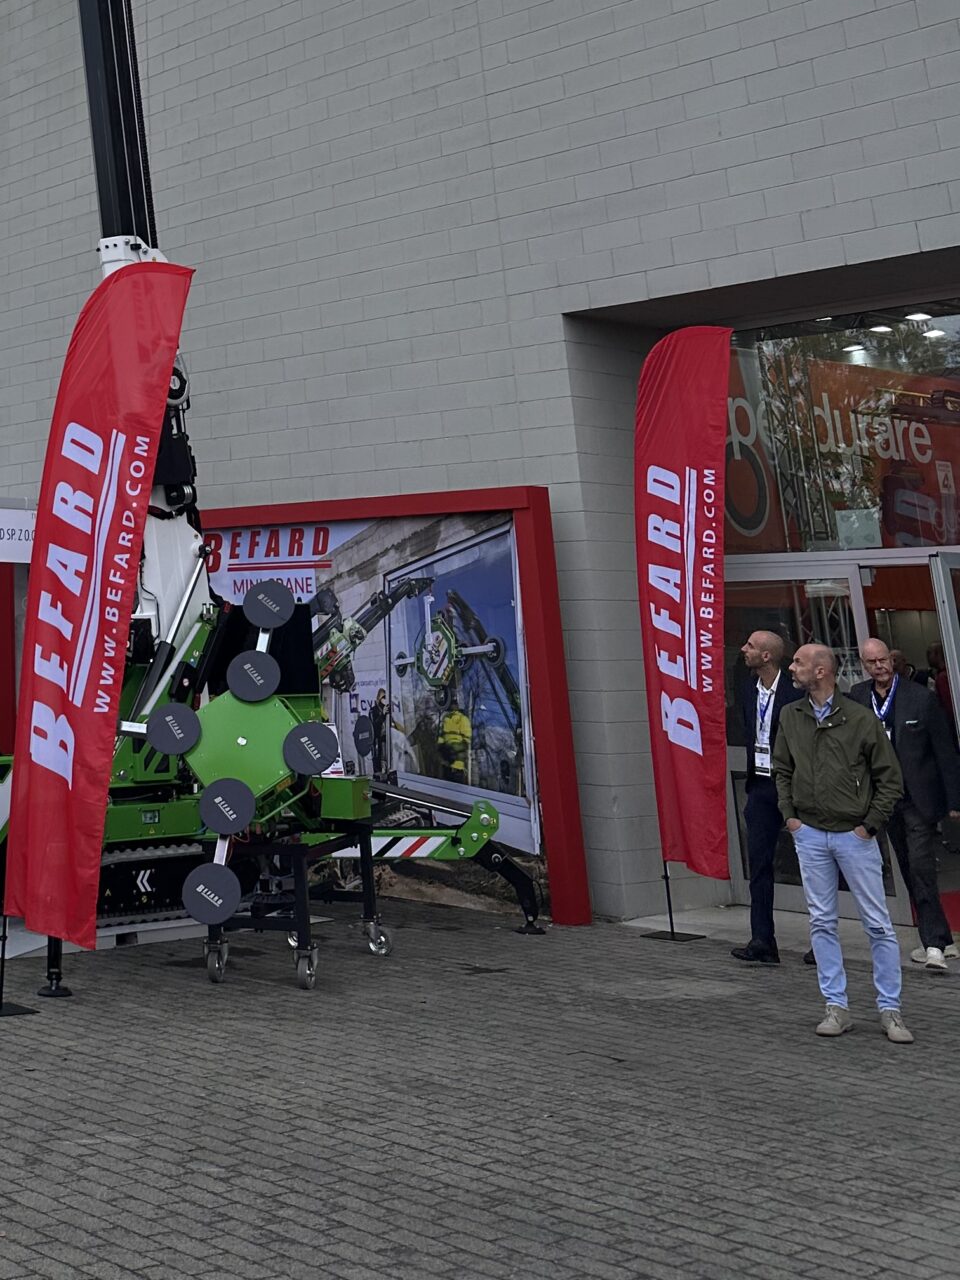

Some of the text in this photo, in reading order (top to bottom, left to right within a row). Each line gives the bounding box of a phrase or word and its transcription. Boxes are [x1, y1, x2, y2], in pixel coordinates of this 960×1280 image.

[813, 392, 932, 464] durare
[18, 528, 23, 541] Z
[203, 526, 330, 573] BEFARD
[233, 577, 313, 595] MIN ANE
[29, 421, 105, 791] BEFARD
[647, 464, 703, 756] BEFARD
[213, 796, 237, 820] BEFARD
[195, 884, 224, 906] BEFARD
